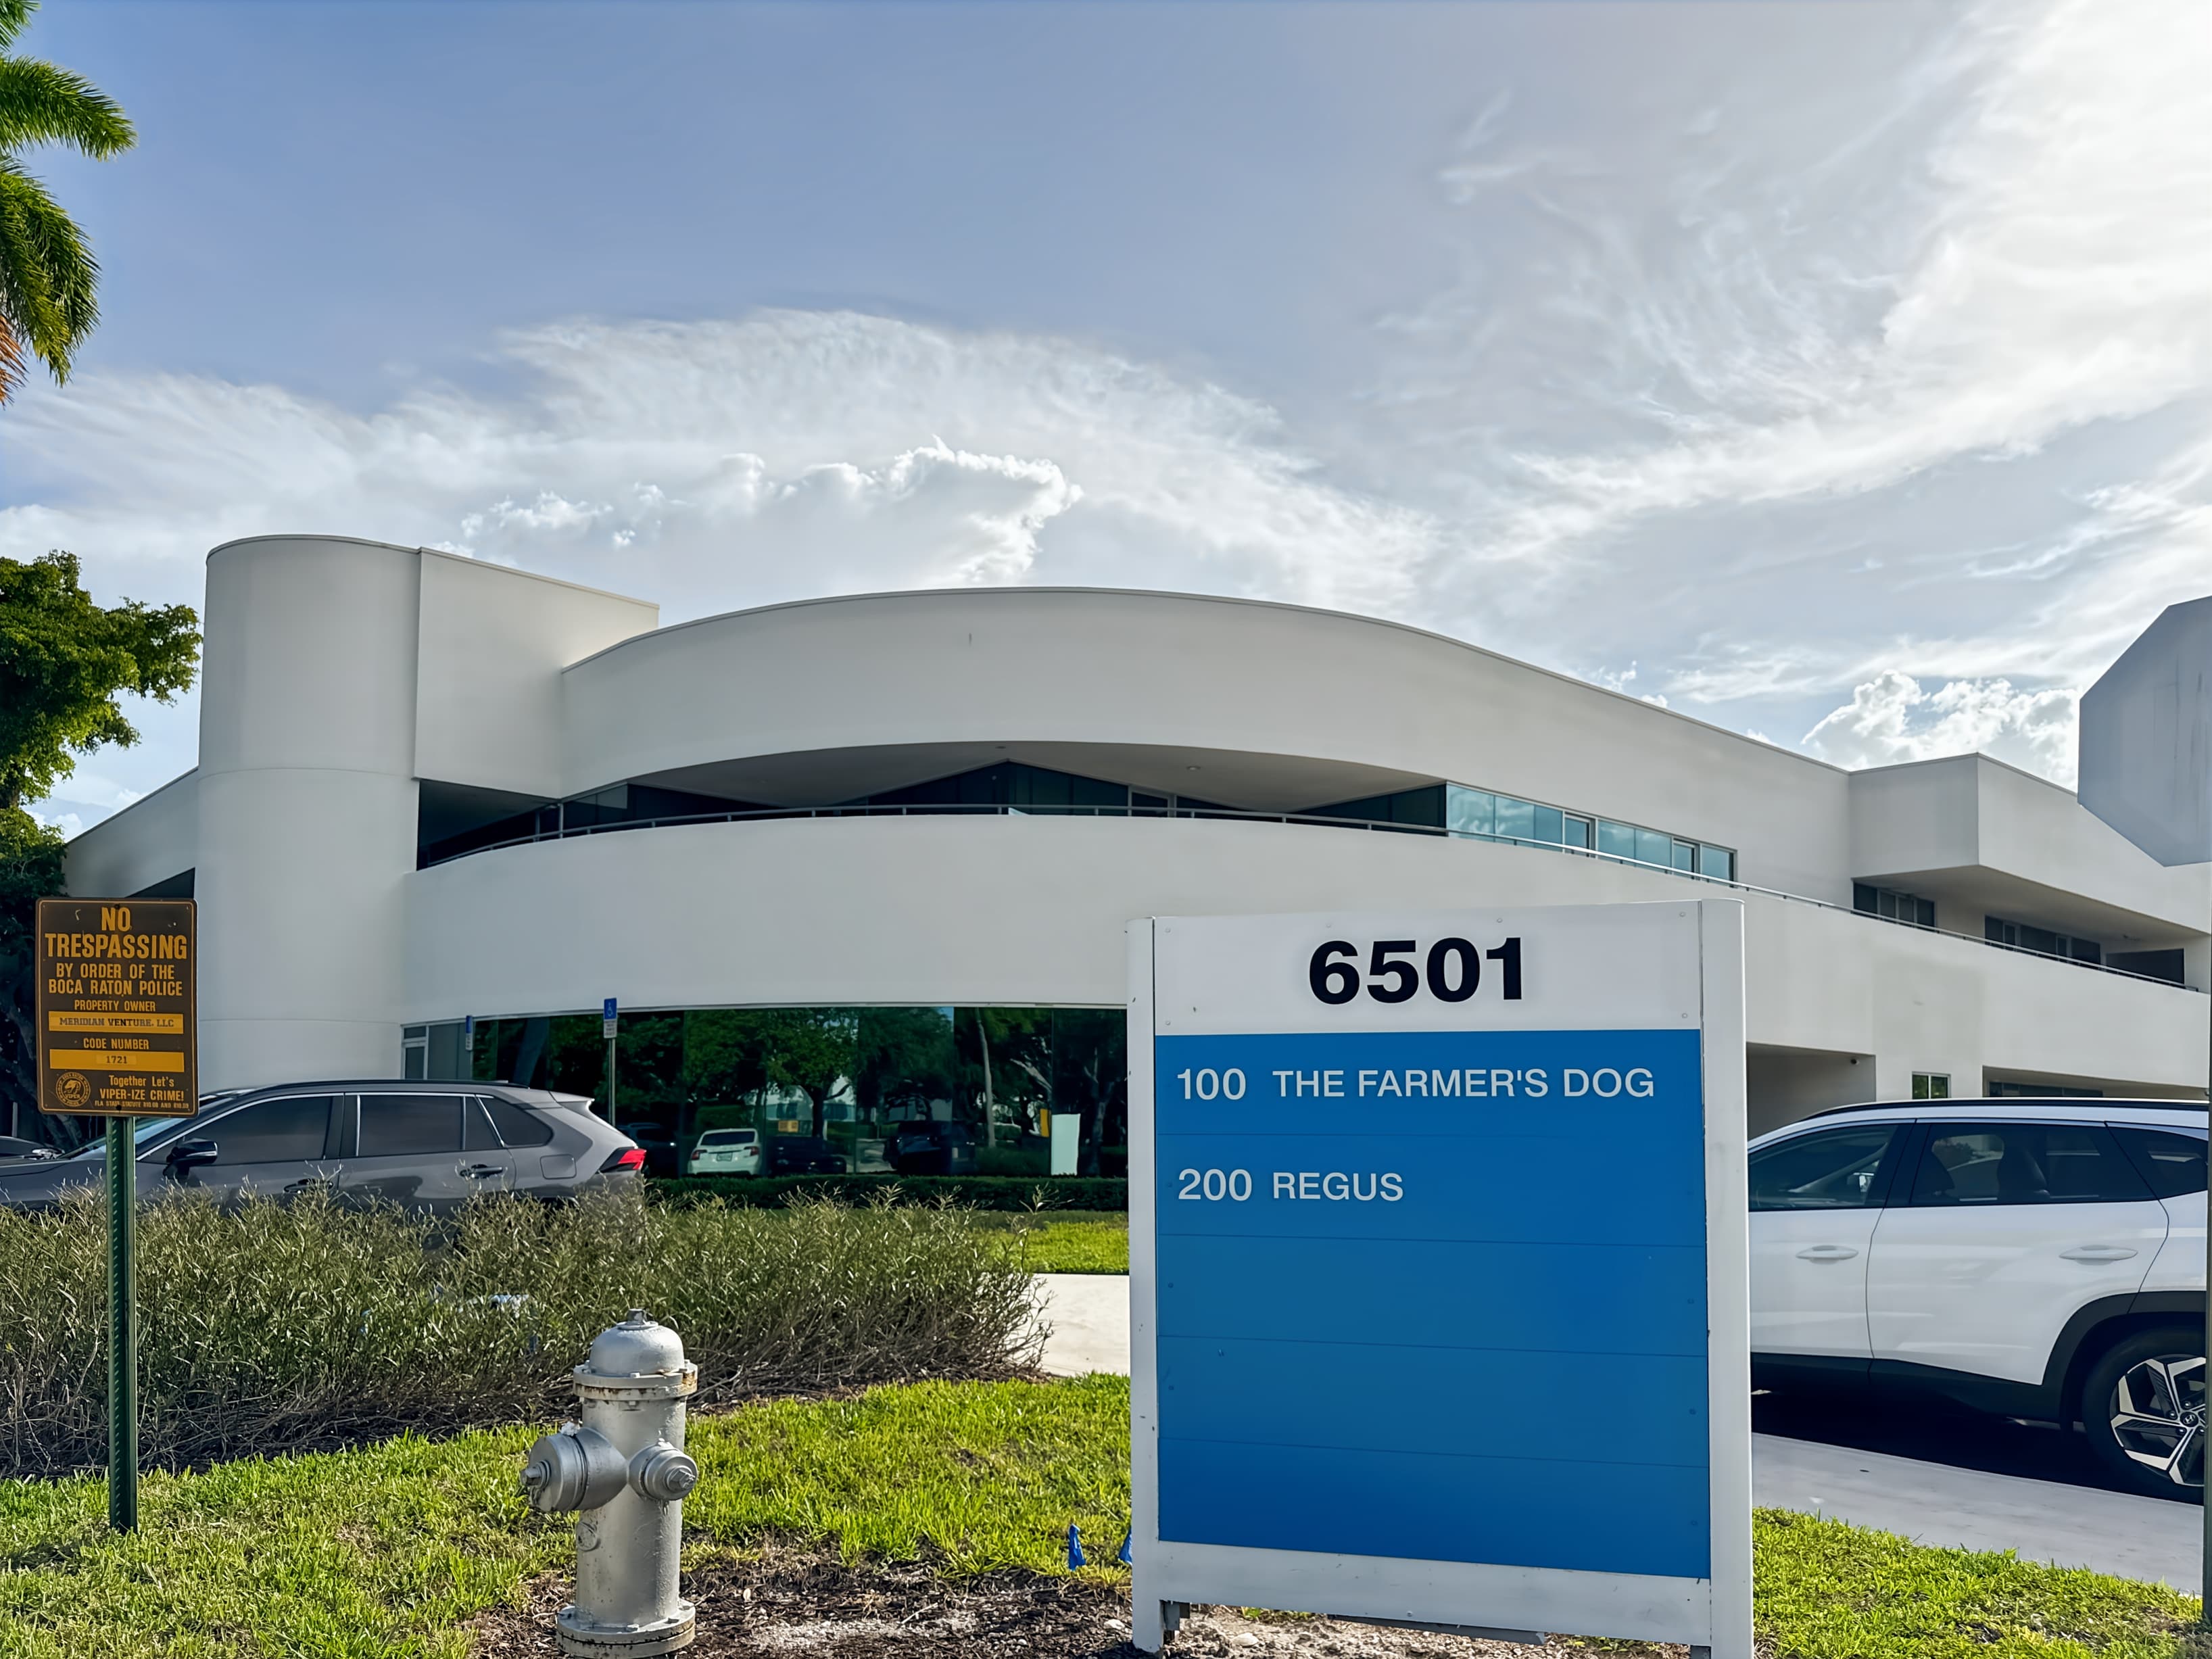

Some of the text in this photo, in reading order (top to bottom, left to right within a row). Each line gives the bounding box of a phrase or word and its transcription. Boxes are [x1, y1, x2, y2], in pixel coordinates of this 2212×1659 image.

[101, 907, 130, 932] NO
[45, 933, 187, 959] TRESPASSING
[56, 963, 174, 979] BY ORDER OF THE
[1309, 936, 1522, 1005] 6501
[49, 979, 183, 996] BOCA RATON POLICE
[74, 1000, 155, 1011] PROPERTY OWNER
[59, 1017, 105, 1026] MERIDIAN
[83, 1038, 149, 1049] CODE NUMBER
[109, 1075, 174, 1087] Together Let's
[1177, 1067, 1655, 1100] 100 THE FARMER'S DOG
[100, 1089, 145, 1100] VIPER-IZE
[150, 1090, 184, 1101] CRIME!
[1178, 1168, 1404, 1201] 200 REGUS
